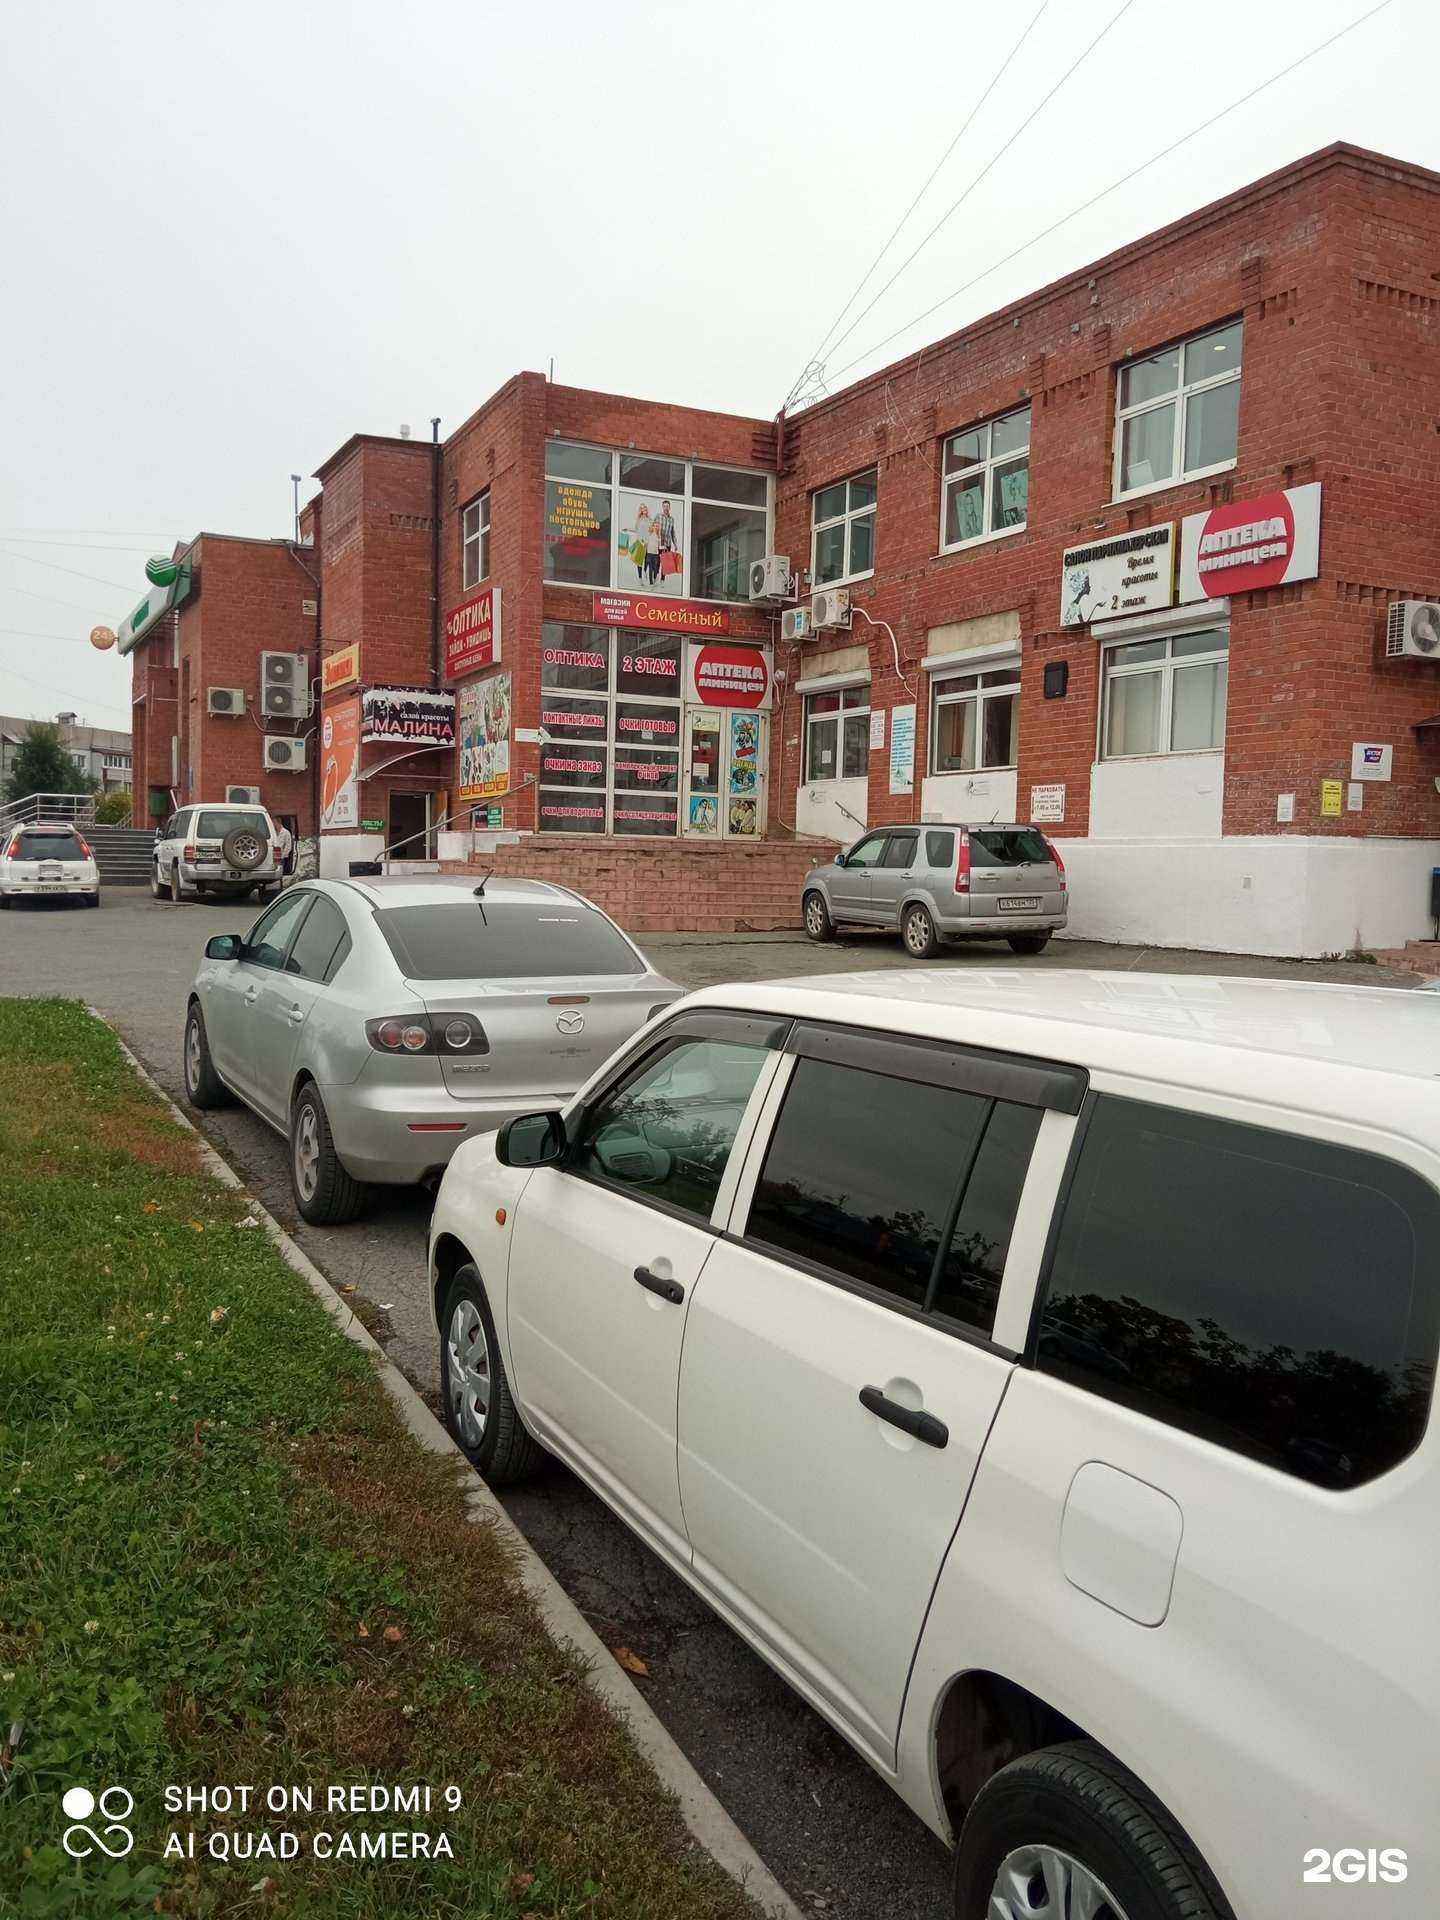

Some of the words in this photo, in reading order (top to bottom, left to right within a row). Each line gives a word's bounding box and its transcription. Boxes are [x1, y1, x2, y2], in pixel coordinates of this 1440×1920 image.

[1200, 517, 1287, 554] АПТЕКА
[1121, 571, 1158, 588] красоты
[1111, 595, 1118, 610] 2
[1121, 596, 1146, 608] этаж
[452, 597, 491, 636] ОПТИКА
[635, 602, 722, 627] Семейный
[544, 649, 605, 668] ОПТИКА
[623, 656, 633, 672] 2
[635, 657, 676, 676] ЭТАЖ
[699, 662, 763, 680] АПТЕКА
[375, 719, 453, 736] МАЛИНА
